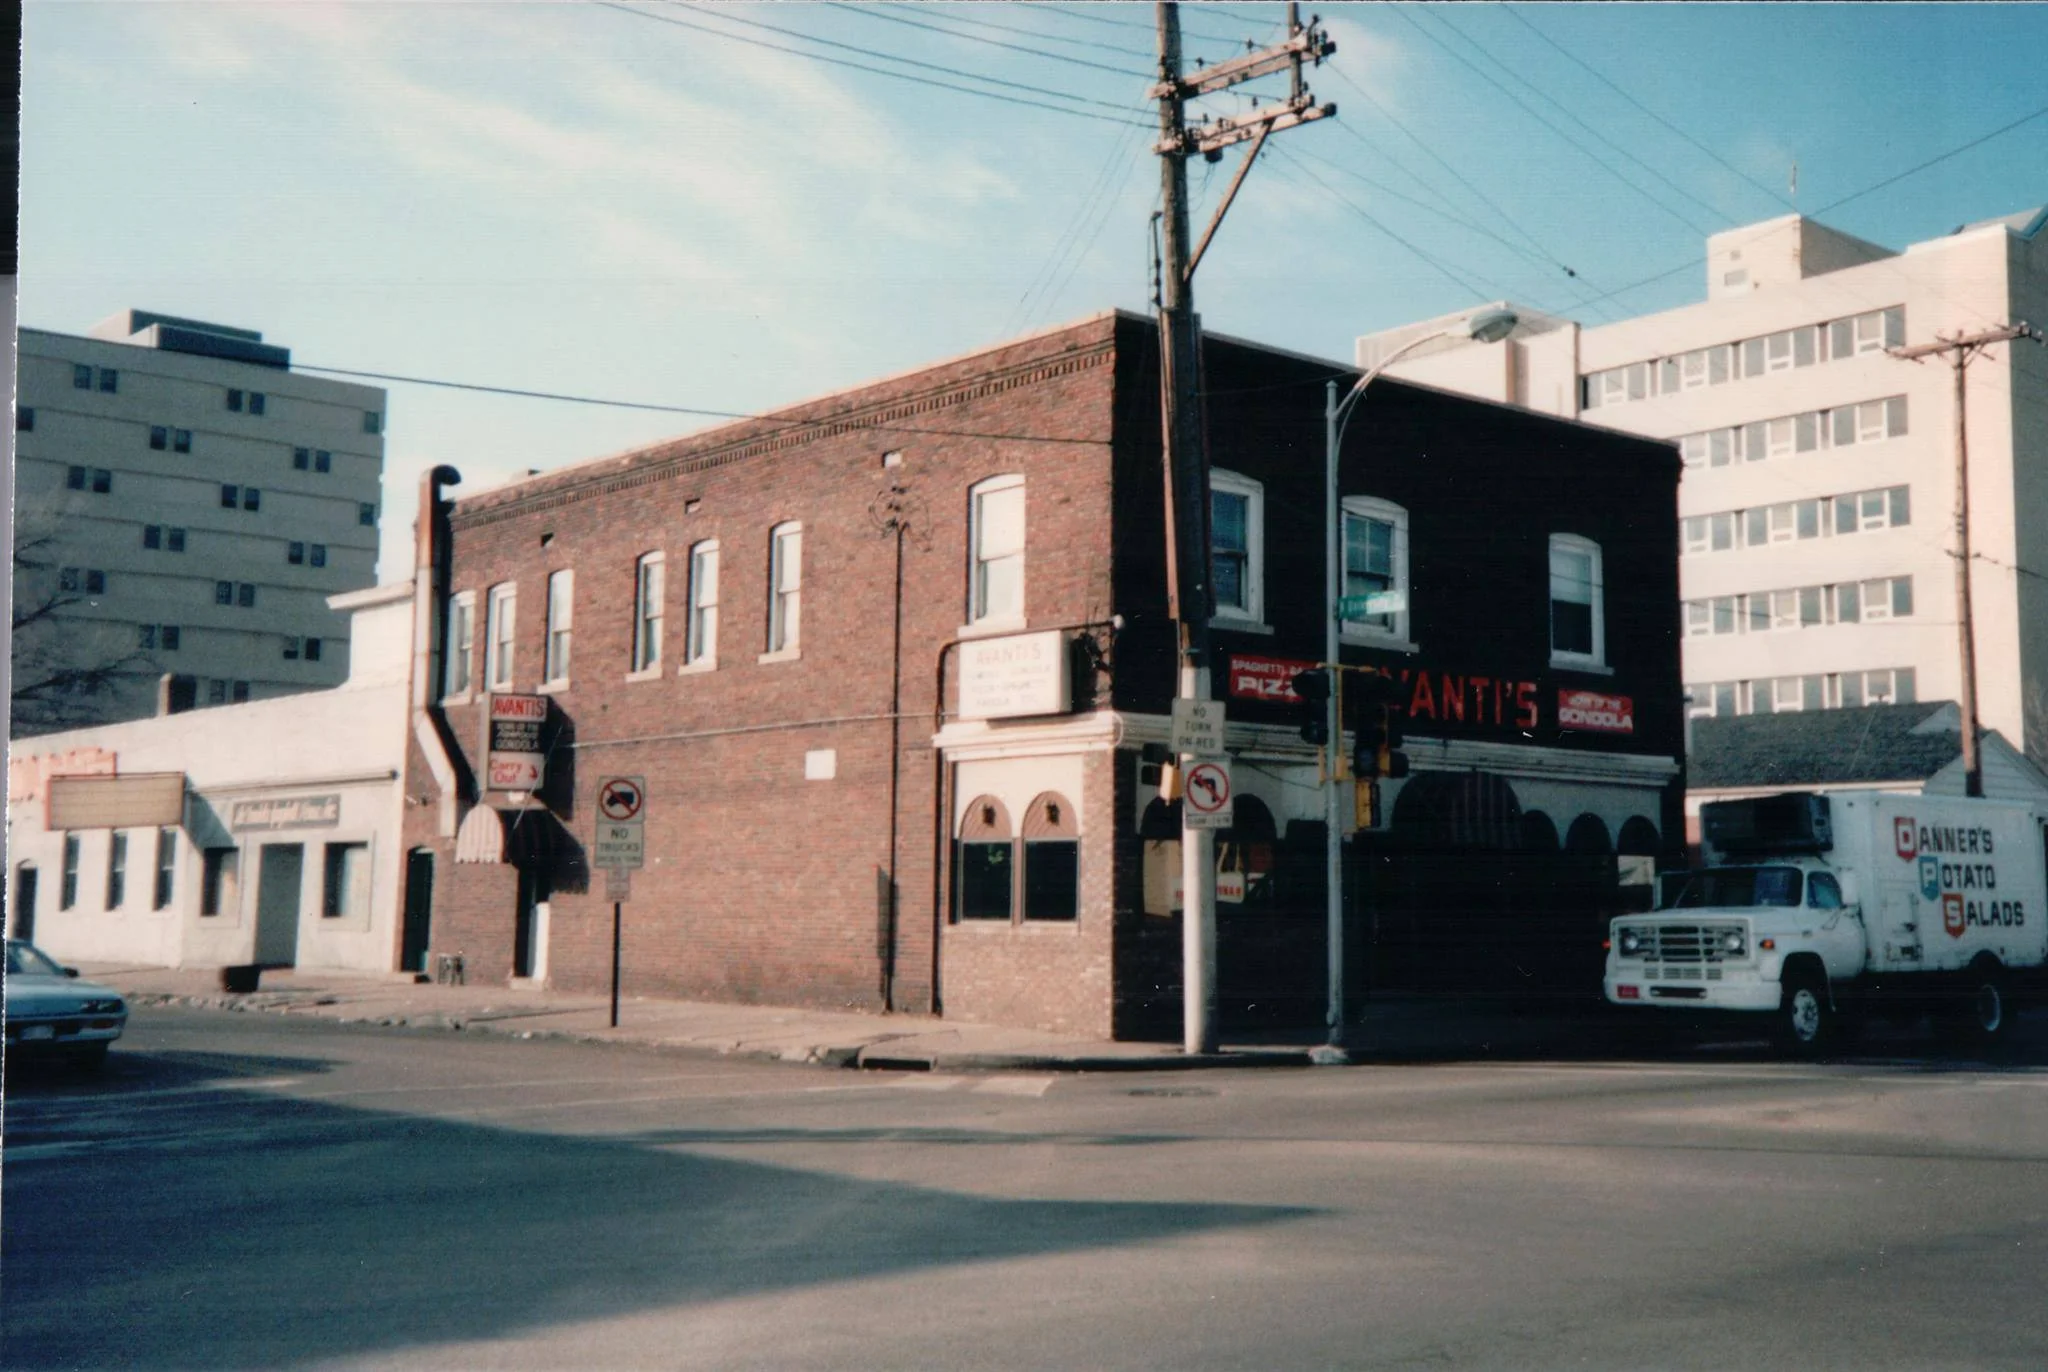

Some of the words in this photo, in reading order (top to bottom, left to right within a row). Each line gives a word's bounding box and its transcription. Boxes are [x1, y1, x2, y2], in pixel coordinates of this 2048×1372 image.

[1237, 676, 1298, 696] PIZZ
[1192, 706, 1207, 718] NO
[1558, 707, 1634, 730] GONDOLA
[1185, 720, 1212, 732] TURN
[1178, 736, 1192, 746] ON
[1195, 736, 1216, 748] RED
[489, 759, 522, 774] Carry
[494, 769, 517, 783] Out
[611, 827, 629, 839] NO
[599, 842, 639, 853] TRUCKS
[1919, 859, 1996, 892] POTATO
[1944, 897, 2025, 931] SALADS
